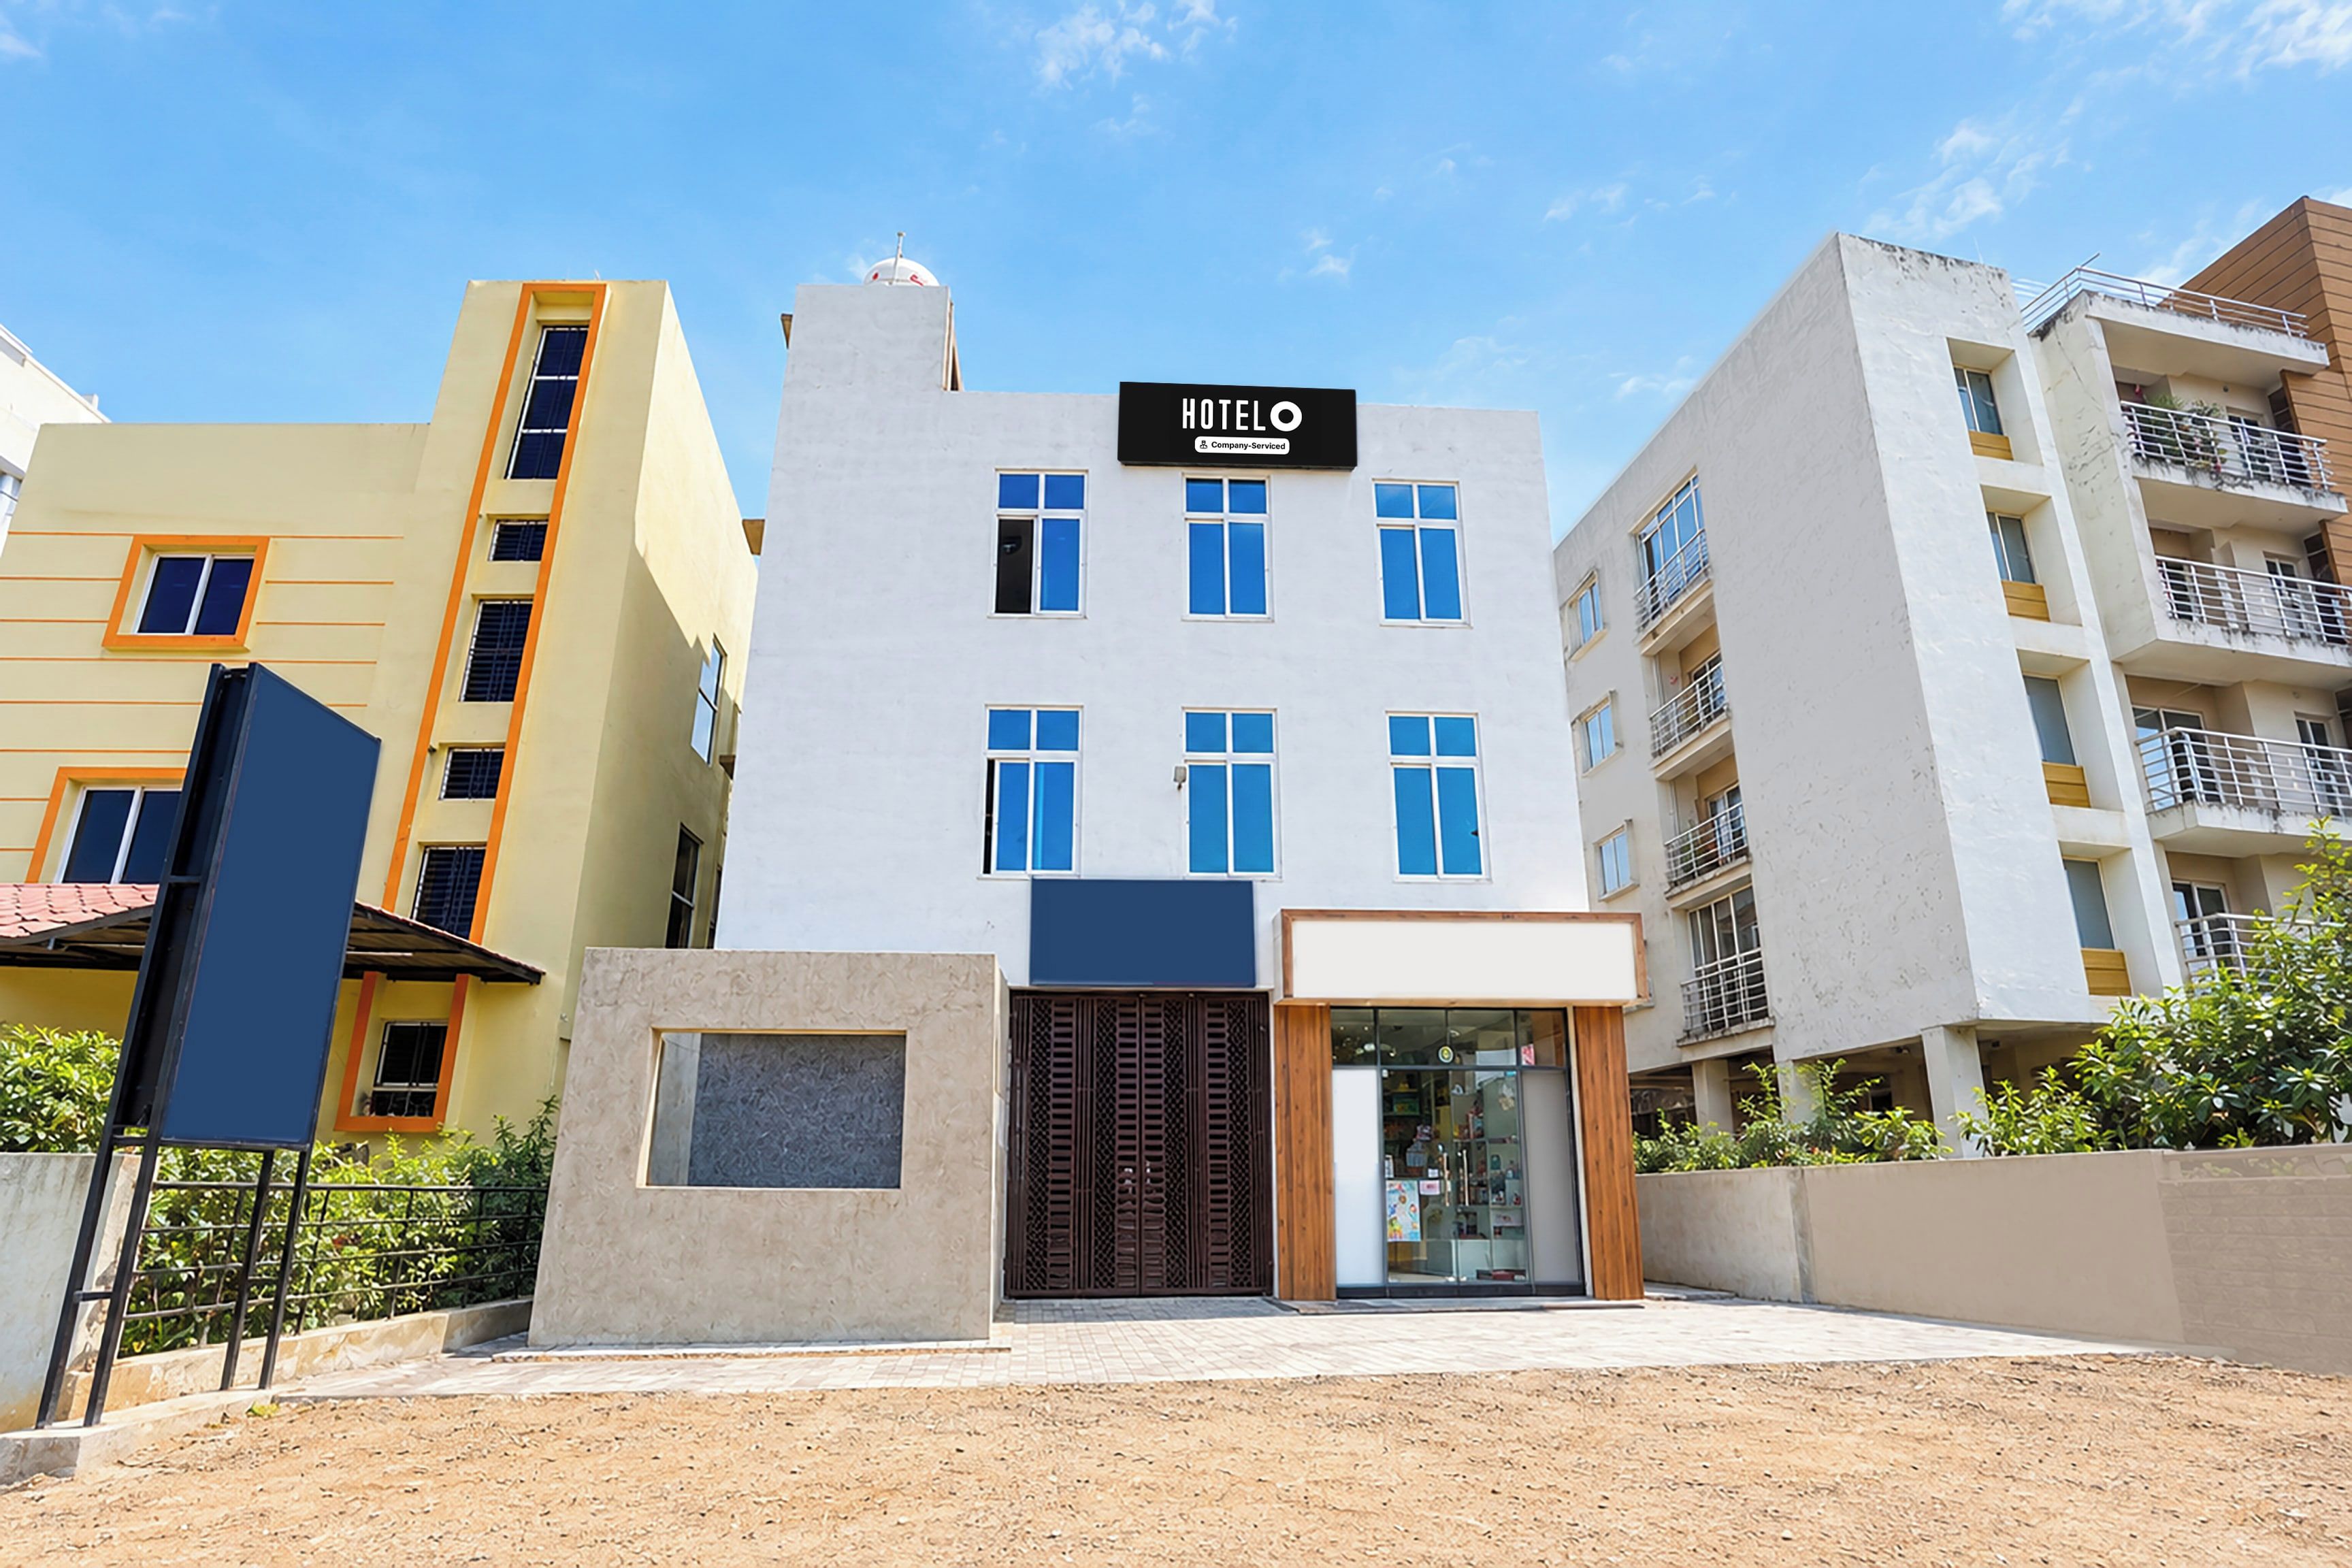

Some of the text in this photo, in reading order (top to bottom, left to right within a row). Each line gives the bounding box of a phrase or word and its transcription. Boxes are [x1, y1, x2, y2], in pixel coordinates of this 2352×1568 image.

[1182, 398, 1303, 432] HOTEL O
[1211, 441, 1286, 451] Company-Serviced
